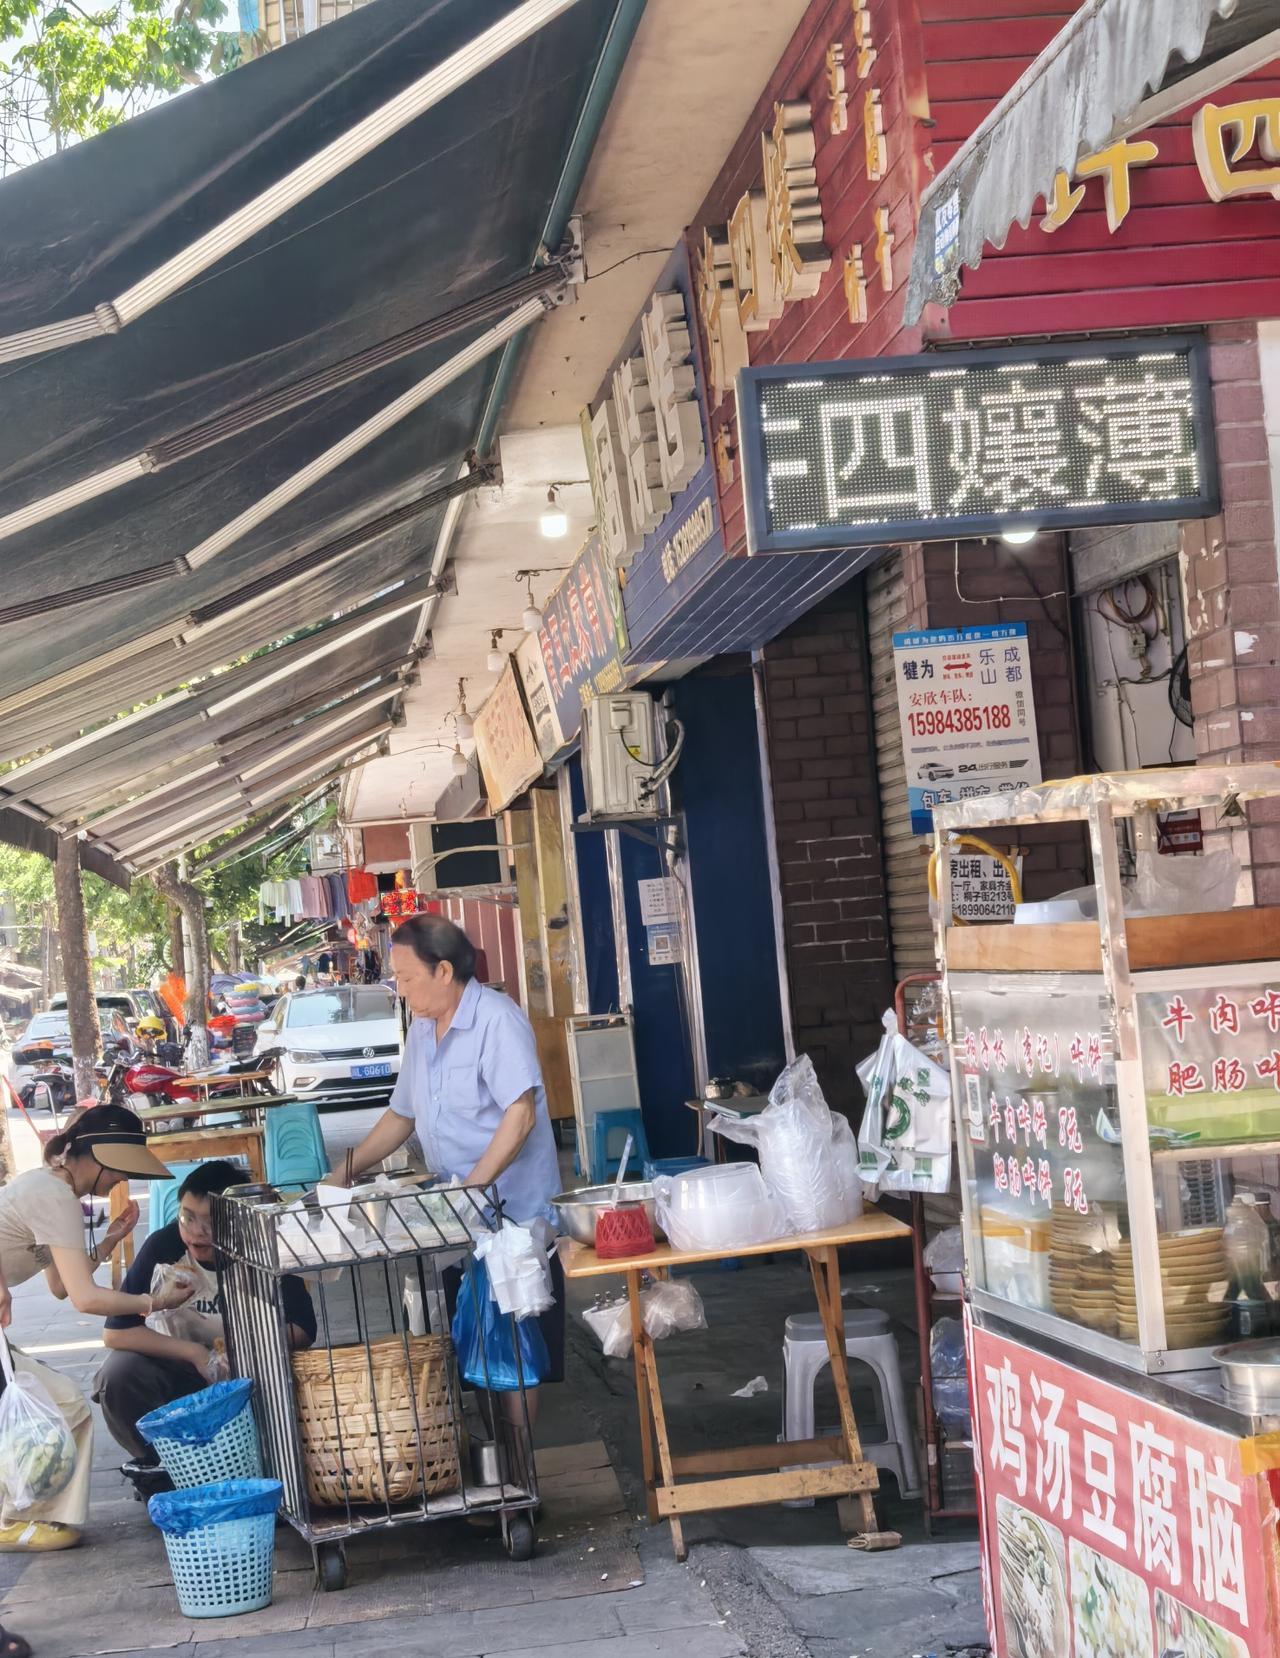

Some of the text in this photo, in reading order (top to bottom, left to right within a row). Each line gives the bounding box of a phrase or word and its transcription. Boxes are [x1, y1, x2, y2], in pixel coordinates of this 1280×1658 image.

[763, 372, 1198, 520] 四孃薄
[902, 659, 935, 681] 犍为
[907, 704, 1012, 737] 15984385188
[984, 1356, 1249, 1628] 鸡汤豆腐脑
